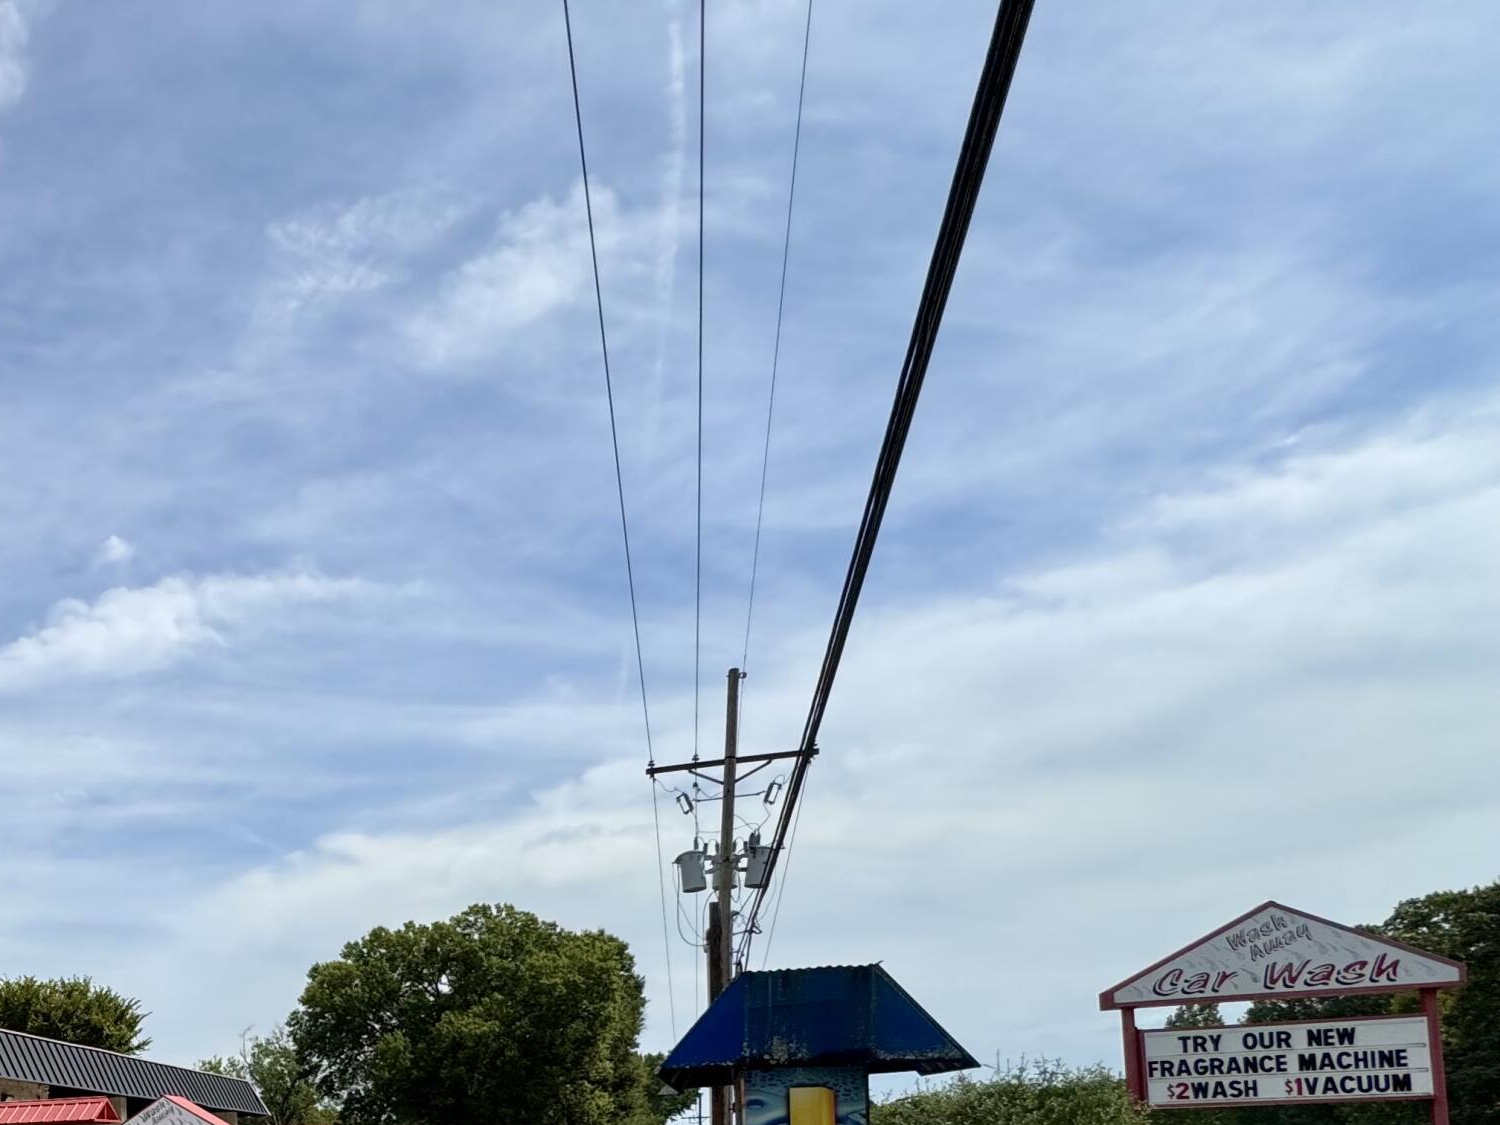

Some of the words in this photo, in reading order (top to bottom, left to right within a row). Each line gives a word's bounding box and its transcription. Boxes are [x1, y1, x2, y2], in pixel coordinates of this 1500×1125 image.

[1225, 914, 1288, 951] Wash
[1249, 923, 1313, 962] Away
[1153, 967, 1237, 996] Car
[1263, 953, 1401, 990] Wash
[1178, 1034, 1222, 1053] TRY
[1242, 1030, 1292, 1050] OUR
[1307, 1027, 1356, 1047] NEW
[1148, 1054, 1288, 1078] FRAGRANCE
[1297, 1049, 1409, 1072] MACHINE
